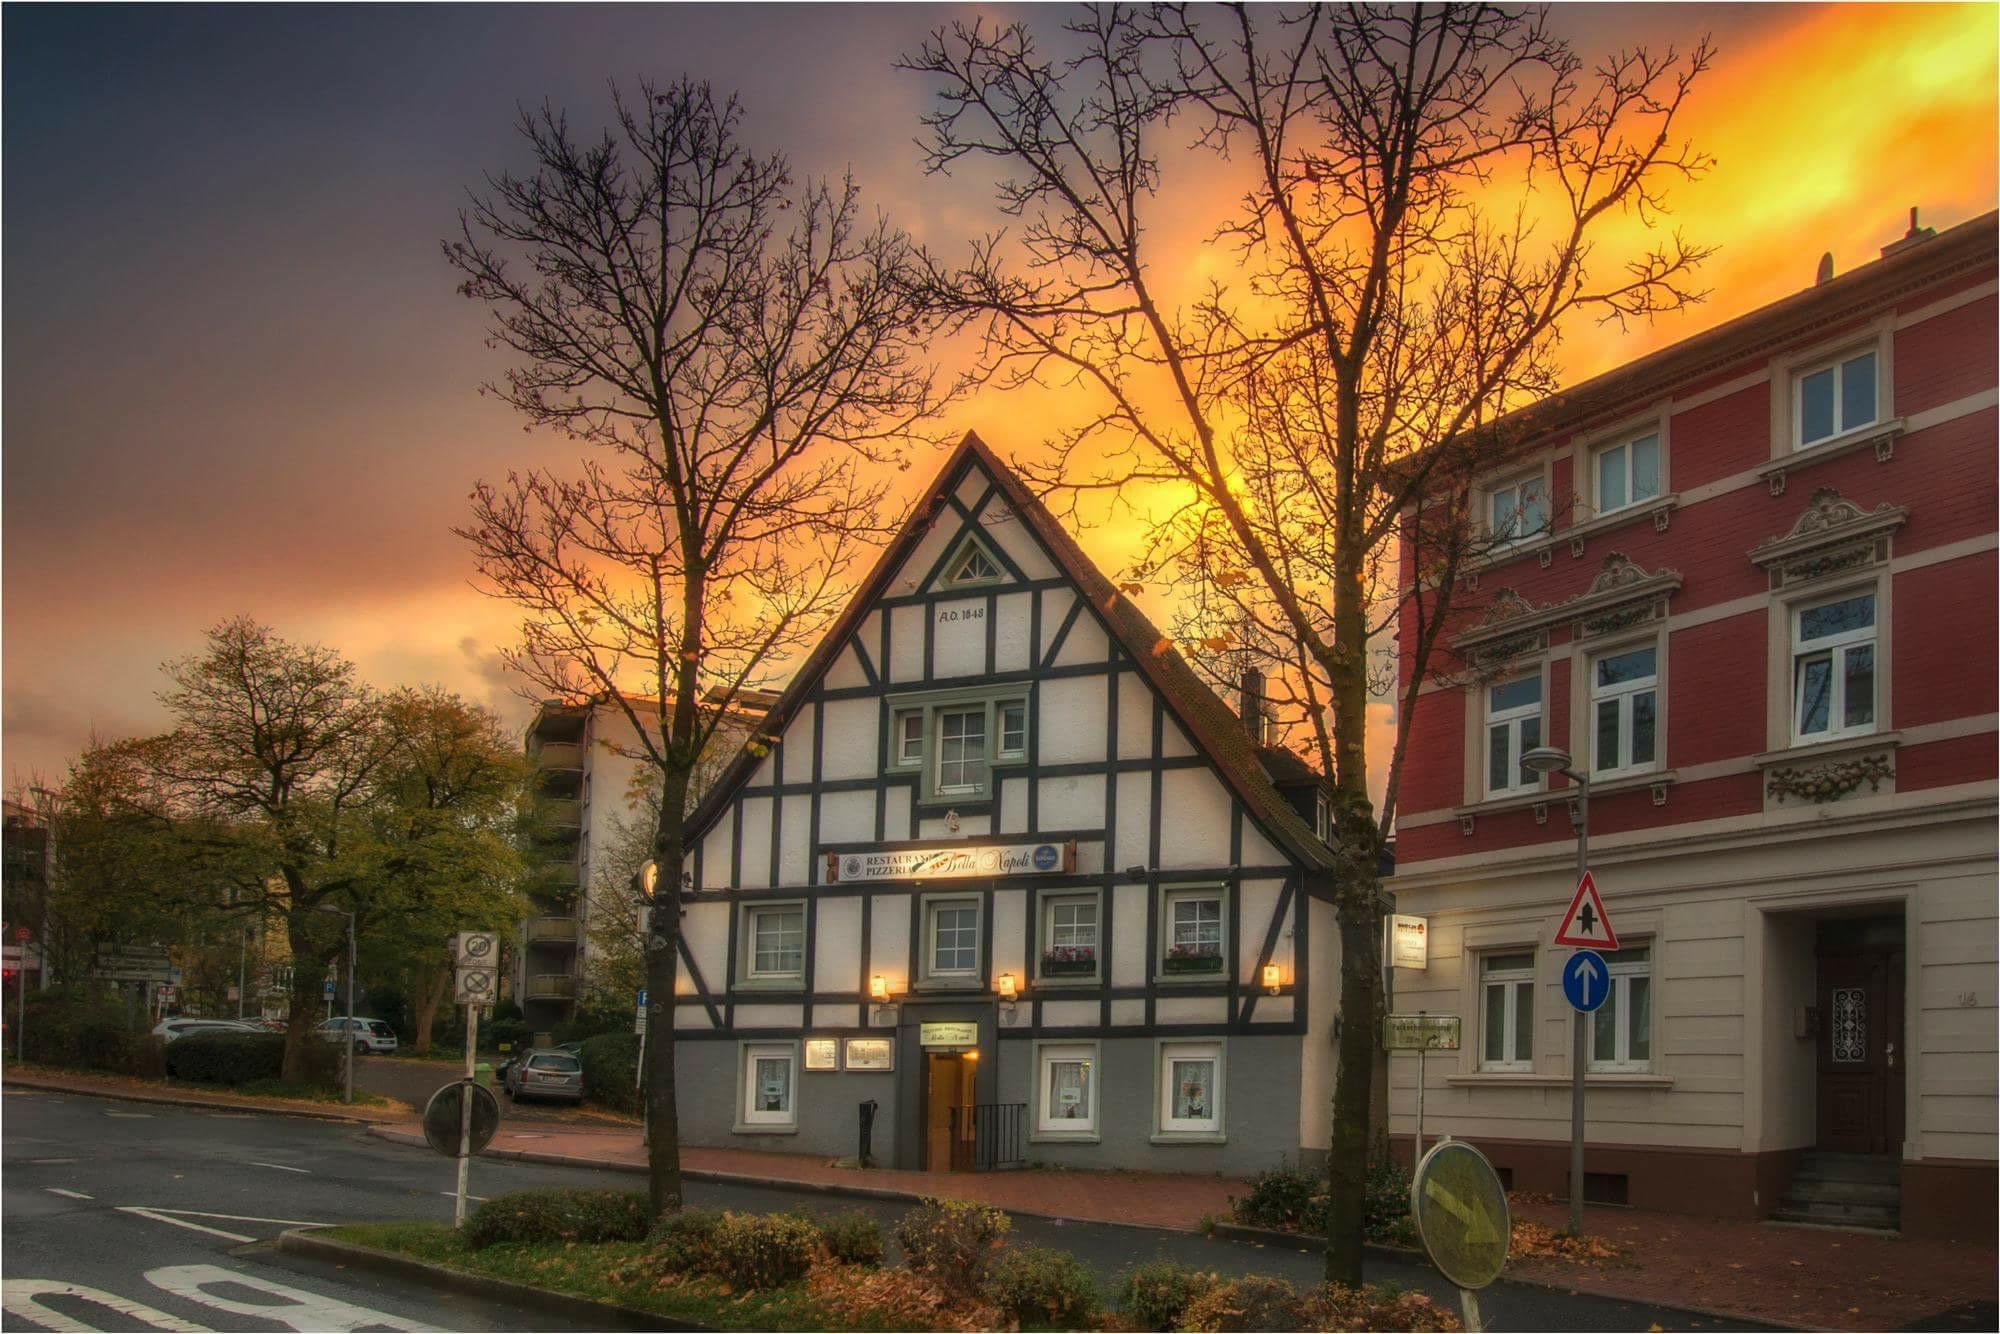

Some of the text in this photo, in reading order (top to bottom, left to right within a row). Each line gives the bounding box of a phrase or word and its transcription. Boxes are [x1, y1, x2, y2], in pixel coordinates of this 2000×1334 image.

[945, 854, 976, 872] Bella
[980, 849, 1030, 872] Napoli
[866, 864, 914, 876] PIZZERIA
